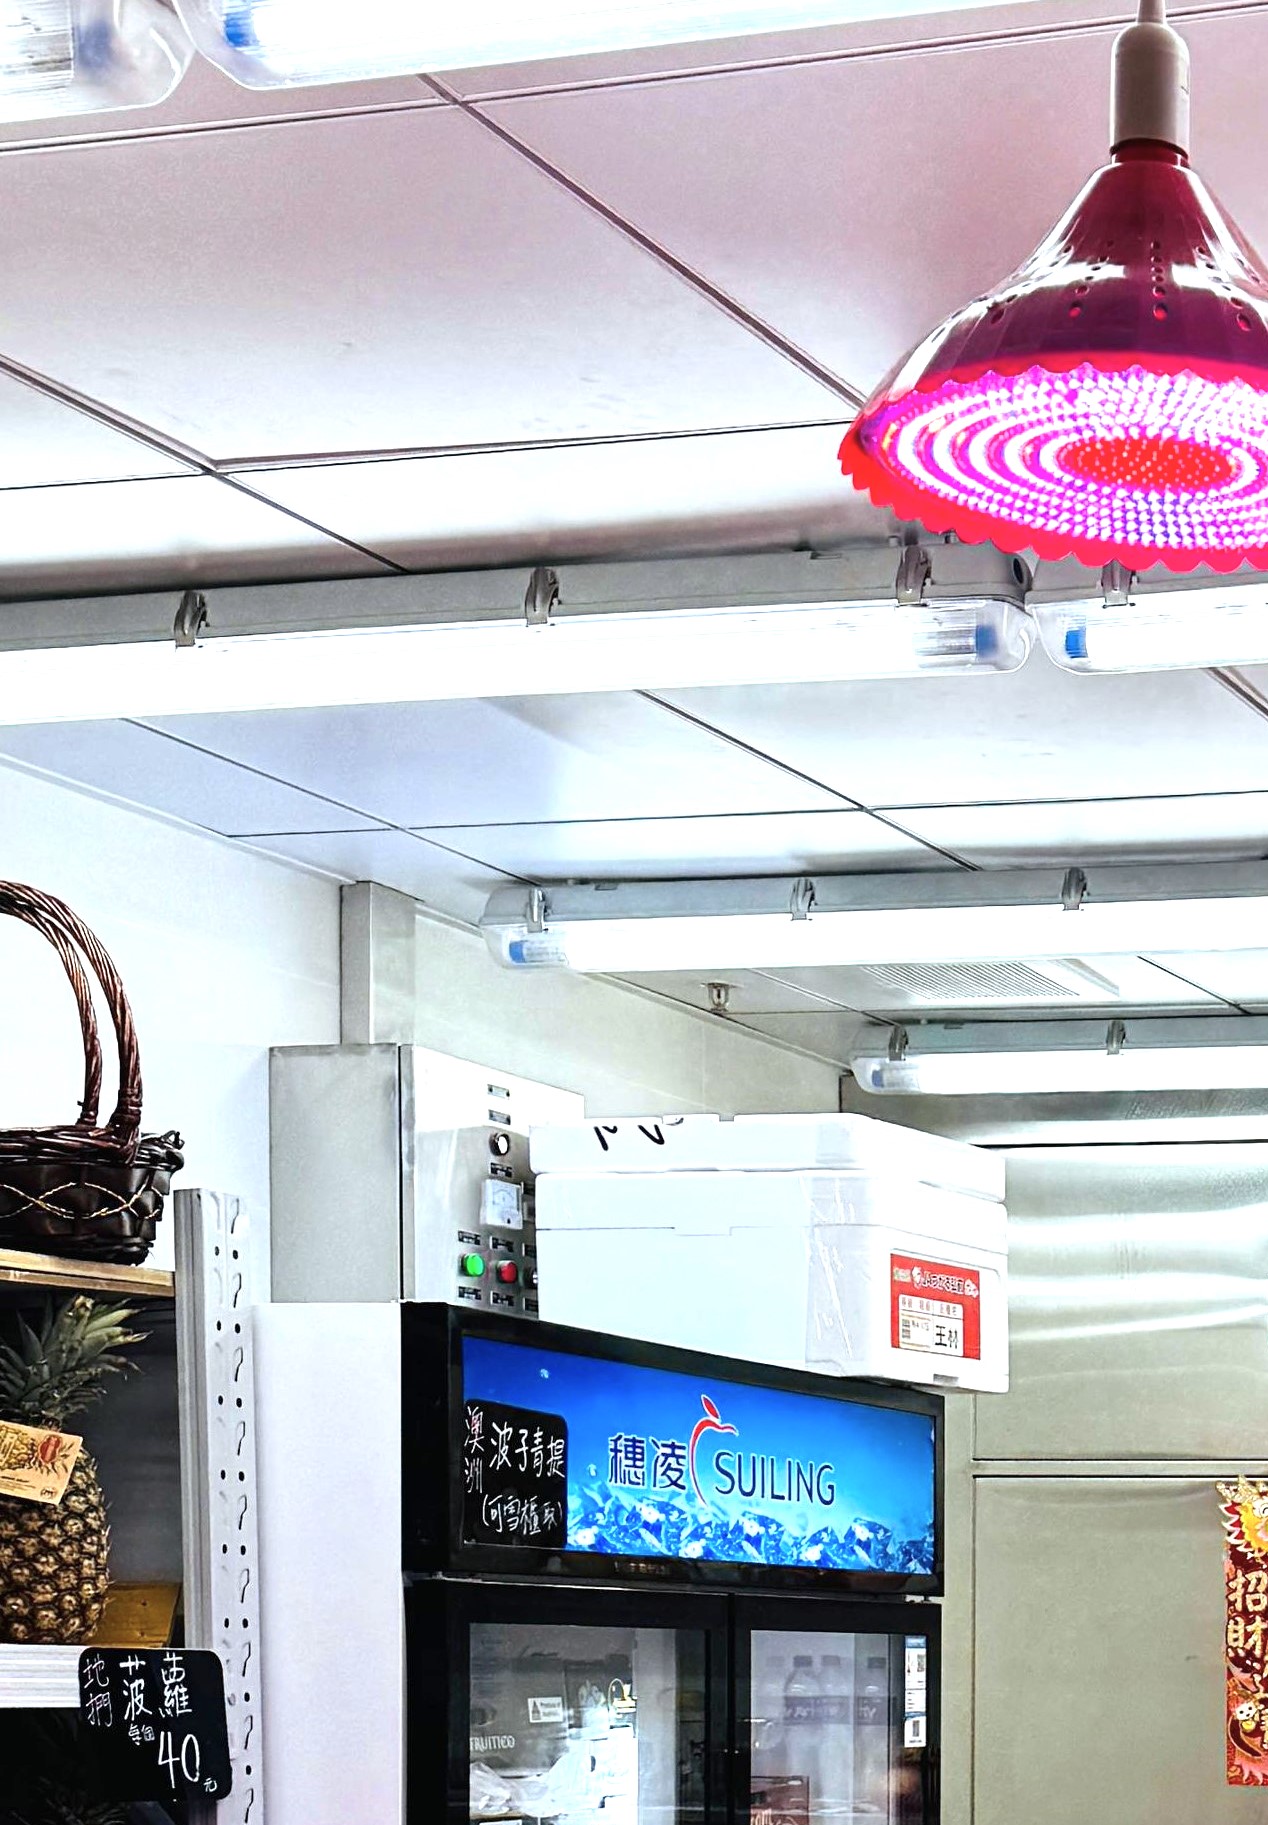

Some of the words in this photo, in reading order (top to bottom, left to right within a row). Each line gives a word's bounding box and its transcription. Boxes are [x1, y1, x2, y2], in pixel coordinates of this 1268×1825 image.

[935, 1325, 960, 1349] 王林
[607, 1432, 689, 1492] 穗凌
[714, 1451, 836, 1506] SUILING
